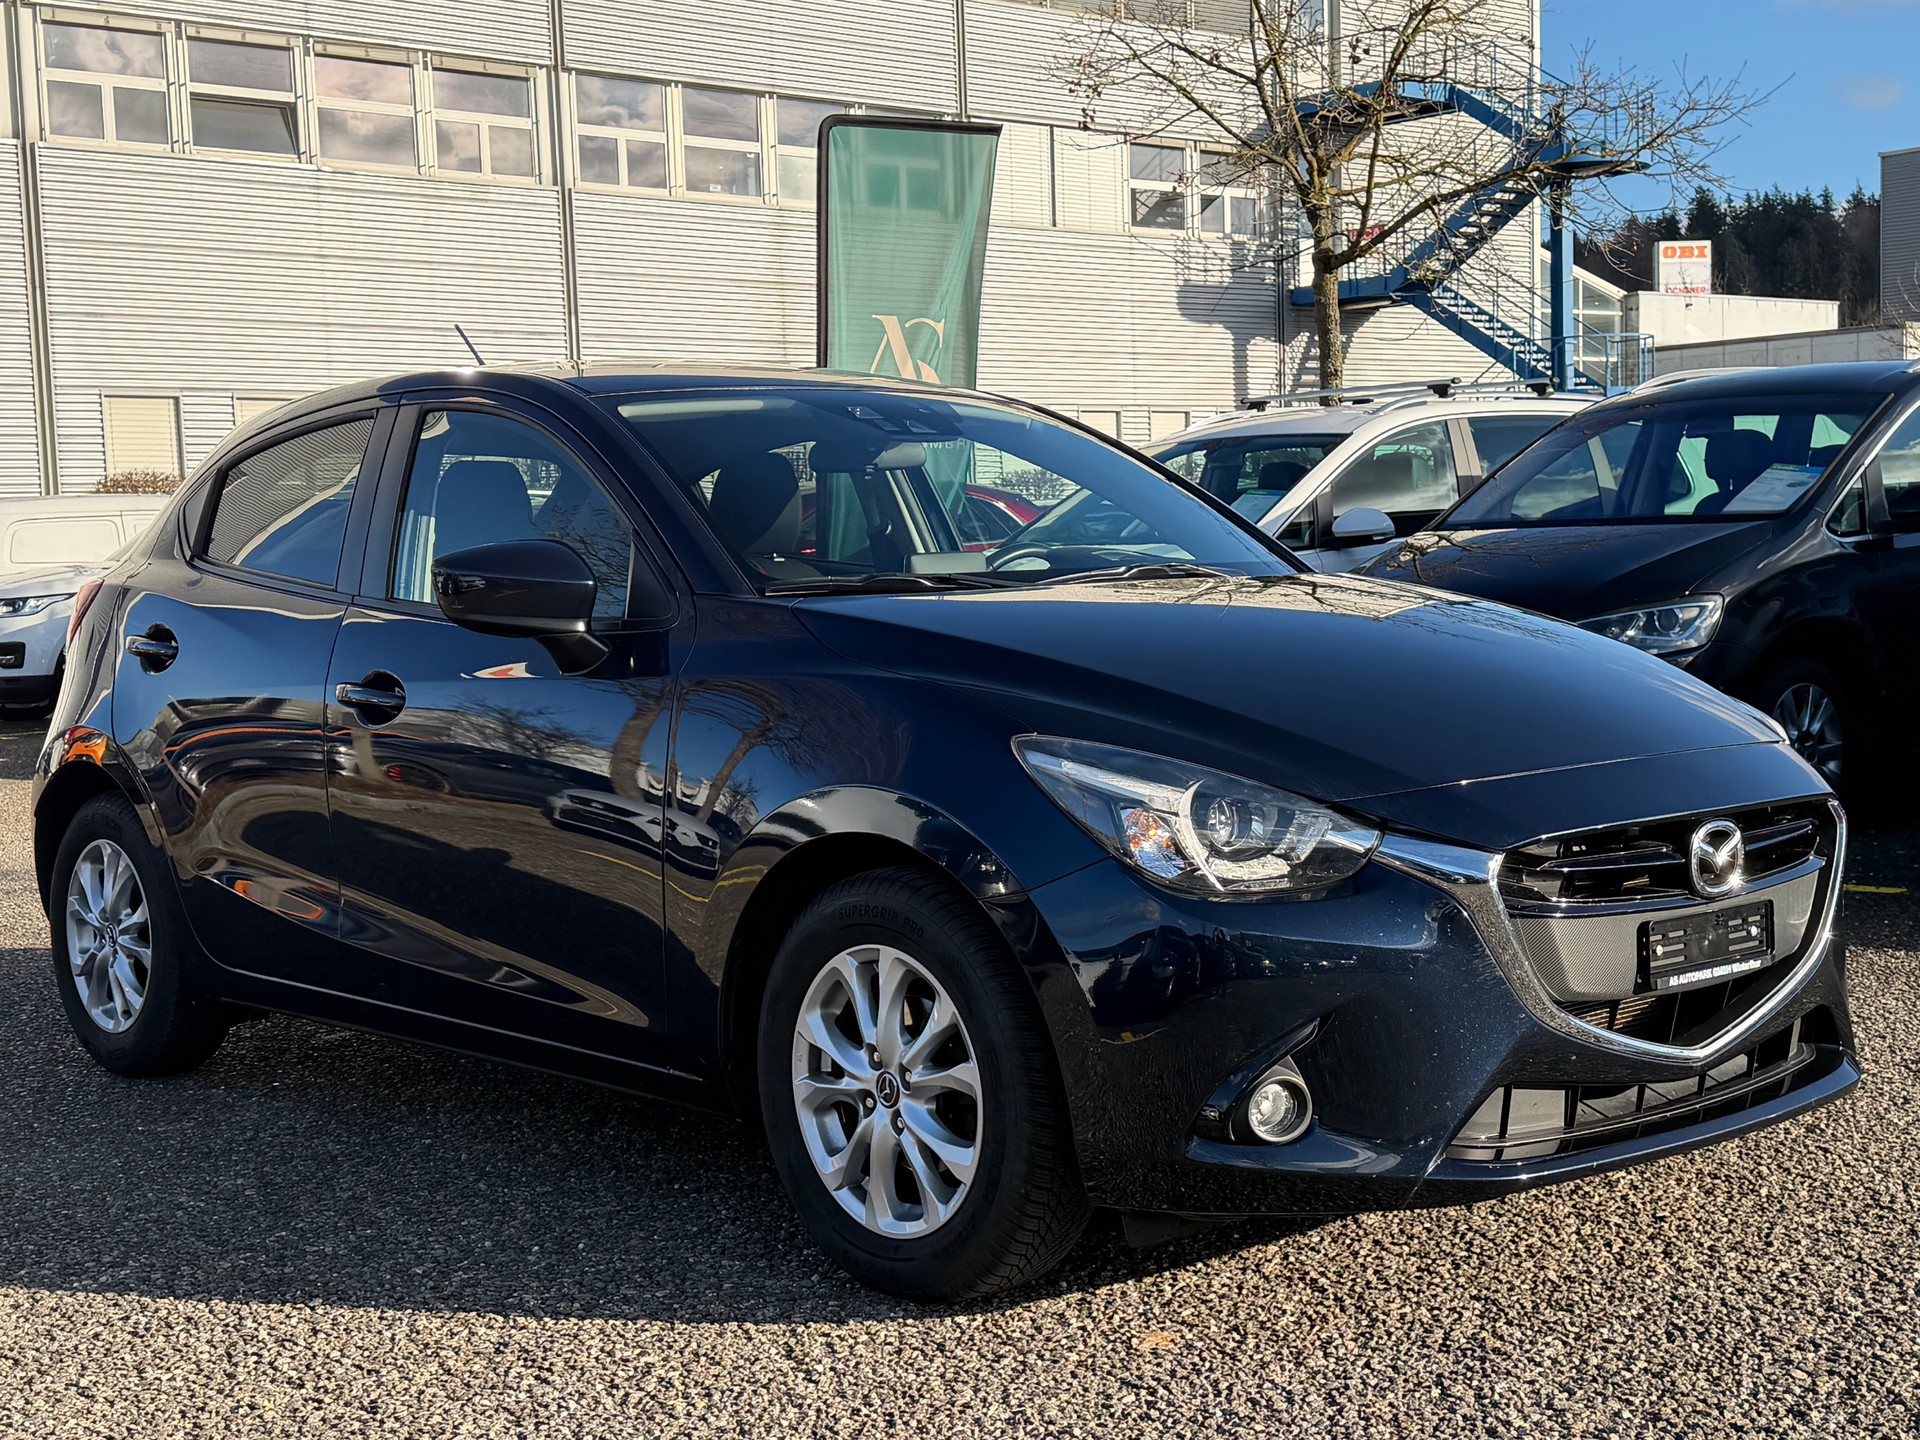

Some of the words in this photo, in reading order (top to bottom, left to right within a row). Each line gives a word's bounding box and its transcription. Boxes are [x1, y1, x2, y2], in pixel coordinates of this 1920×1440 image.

[1662, 245, 1708, 259] OBI
[839, 904, 899, 922] SUPERGRIP
[902, 917, 925, 938] PRO
[1669, 976, 1679, 987] AS
[1678, 968, 1713, 985] AUTOPARK
[1713, 964, 1732, 978] GMBH
